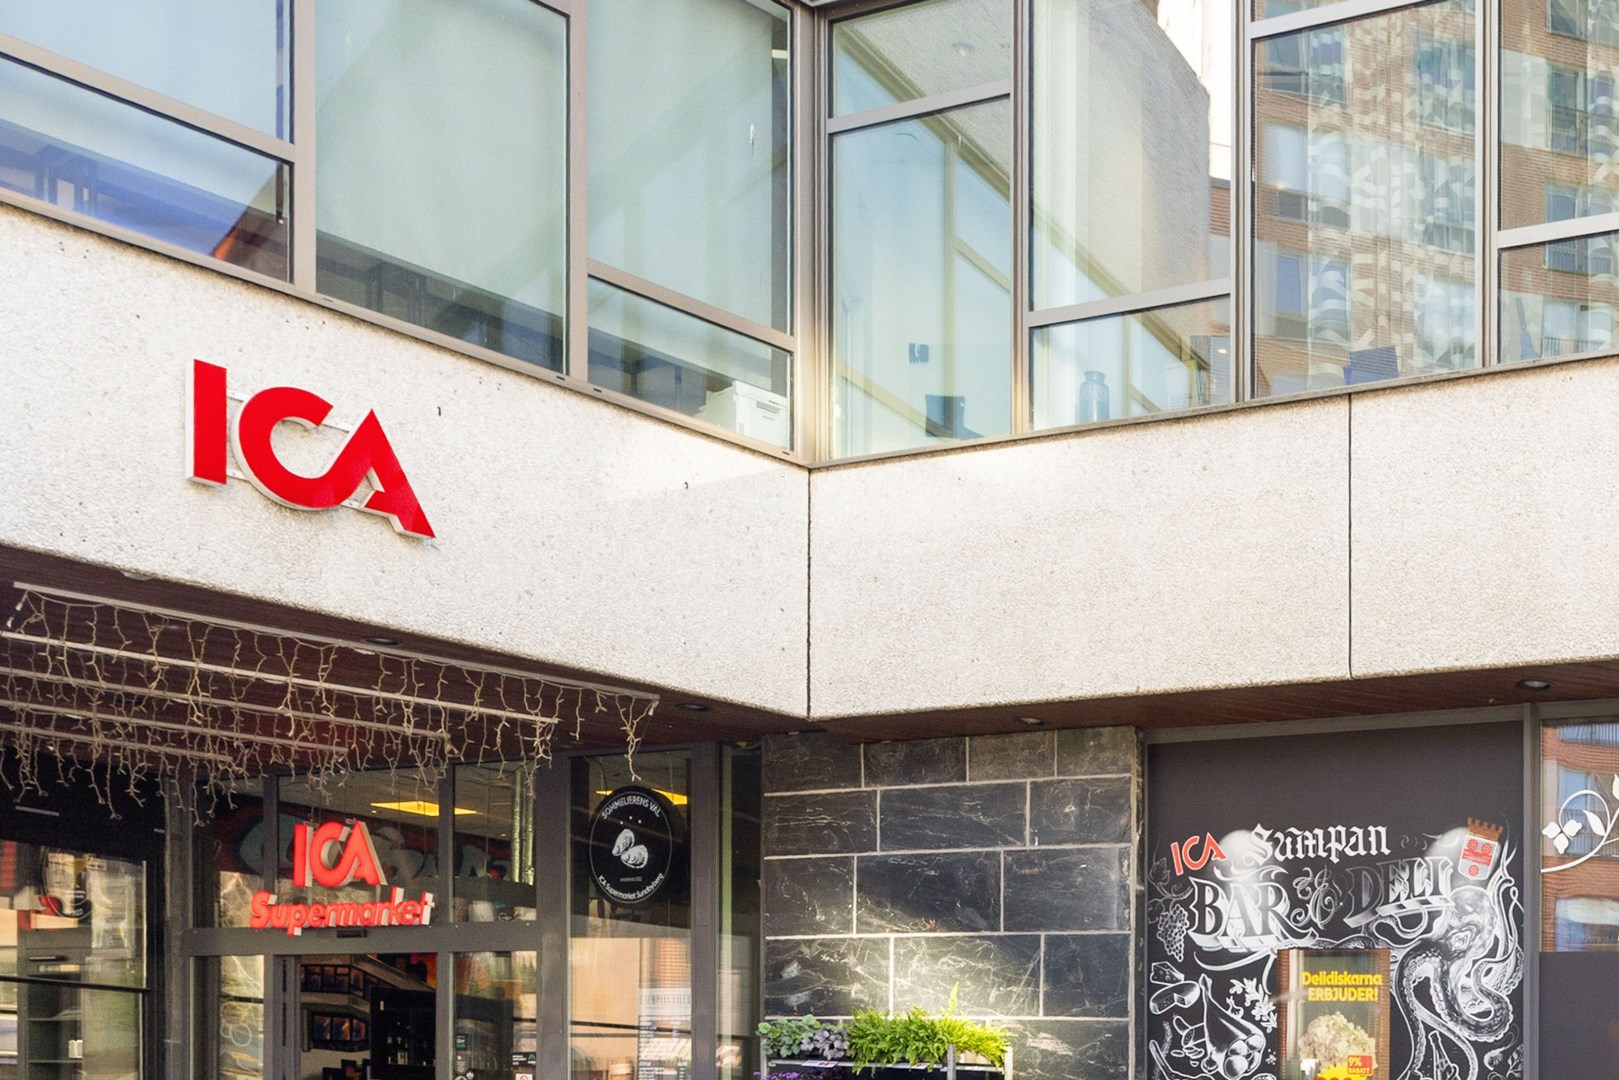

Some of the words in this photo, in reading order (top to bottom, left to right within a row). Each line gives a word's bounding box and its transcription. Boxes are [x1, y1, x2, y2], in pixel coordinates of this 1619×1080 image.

[186, 359, 434, 539] ICA
[602, 795, 649, 819] SOMMELIERENS
[649, 802, 662, 818] VAL
[293, 820, 388, 888] ICA
[1170, 832, 1227, 876] ICA
[598, 875, 607, 886] ICA
[605, 883, 637, 900] Supermarket
[636, 873, 664, 898] Sundbyberg
[250, 886, 435, 936] Supermarket
[1187, 876, 1319, 953] BAR
[1343, 856, 1456, 928] DELI
[1302, 971, 1382, 986] Delidiskarna
[1308, 987, 1378, 1002] ERBJUDER!
[1348, 1056, 1362, 1067] 9%
